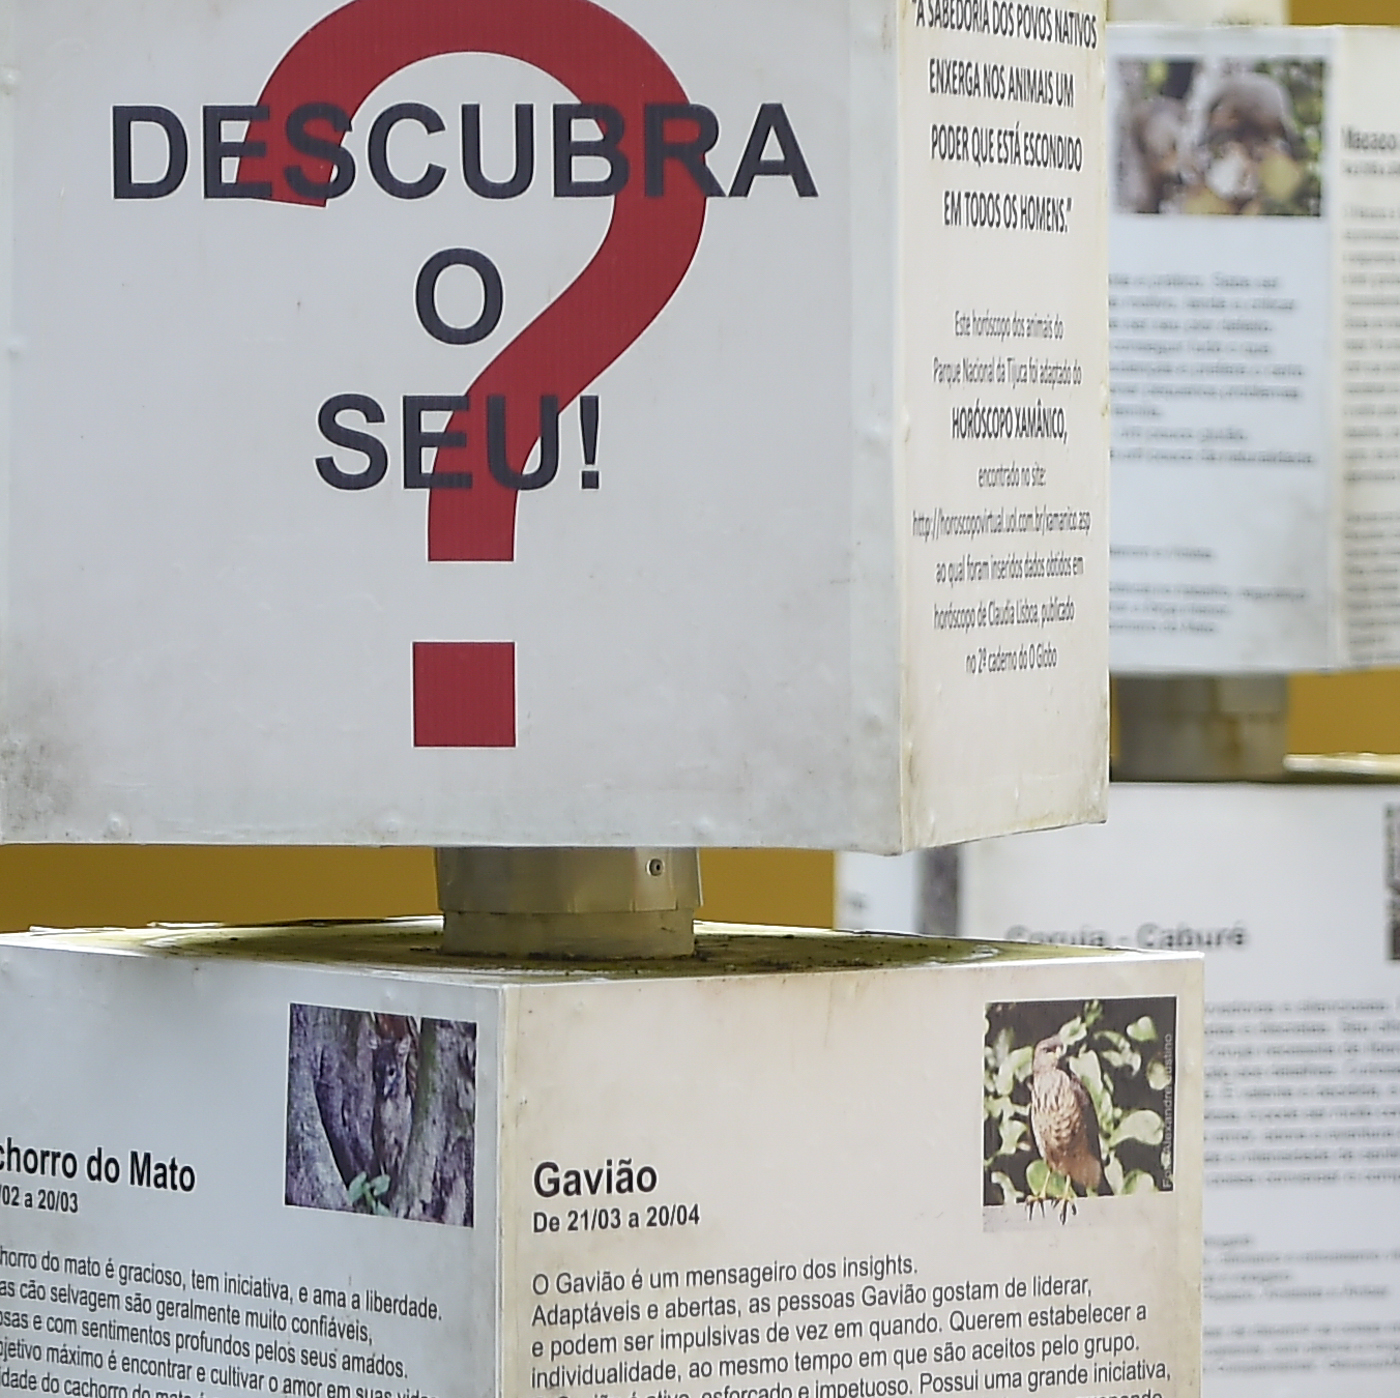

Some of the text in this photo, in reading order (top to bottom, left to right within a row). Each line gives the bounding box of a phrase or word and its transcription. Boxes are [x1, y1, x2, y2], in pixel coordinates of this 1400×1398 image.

[928, 0, 991, 33] SABEDORIA
[992, 1, 1014, 36] DOS
[1017, 4, 1052, 42] POVOS
[1055, 9, 1097, 49] NATIVOS
[928, 57, 1074, 108] ENXERGA NOS ANIMAIS UM
[112, 102, 819, 200] DESCUBRA
[930, 120, 1083, 173] PODER QUE ESTÁ ESCONDIDO
[943, 189, 962, 227] EM
[963, 190, 1002, 229] TODOS
[1002, 192, 1018, 230] OS
[415, 247, 504, 346] O
[954, 309, 1066, 342] Este horóscopo dos animais do
[933, 356, 1082, 390] Parque Nacional da Tijuca foi adaptado do
[314, 393, 601, 491] SEU!
[951, 397, 1068, 445] HORÓSCOPO XAMÂNICO,
[86, 1146, 121, 1184] do
[129, 1149, 196, 1193] Mato
[533, 1157, 658, 1199] Gavião
[23, 1192, 34, 1209] a
[36, 1188, 79, 1214] 20/03
[532, 1202, 700, 1234] De 21/03 a 20/04
[40, 1249, 61, 1273] do
[63, 1255, 102, 1278] mato
[104, 1256, 115, 1279] é
[117, 1262, 187, 1293] gracioso,
[190, 1268, 220, 1294] tem
[223, 1271, 294, 1306] iniciativa,
[298, 1285, 309, 1304] e
[312, 1287, 347, 1309] ama
[350, 1292, 361, 1311] a
[365, 1289, 442, 1321] liberdade.
[532, 1253, 918, 1296] O Gavião é um mensageiro dos insights.
[19, 1278, 47, 1301] cão
[49, 1282, 121, 1313] selvagem
[124, 1291, 153, 1315] são
[155, 1297, 241, 1326] geralmente
[244, 1307, 287, 1332] muito
[290, 1313, 373, 1347] confiáveis,
[531, 1274, 1092, 1331] Adaptáveis e abertas, as pessoas Gavião gostam de liderar,
[531, 1302, 1147, 1363] e podem ser impulsivas de vez em quando. Querem estabelecer a
[531, 1333, 1140, 1394] individualidade, ao mesmo tempo em que são aceitos pelo grupo.
[919, 1368, 979, 1395] Possui
[983, 1371, 1022, 1391] uma
[1027, 1362, 1089, 1393] grande
[1093, 1358, 1171, 1384] iniciativa,
